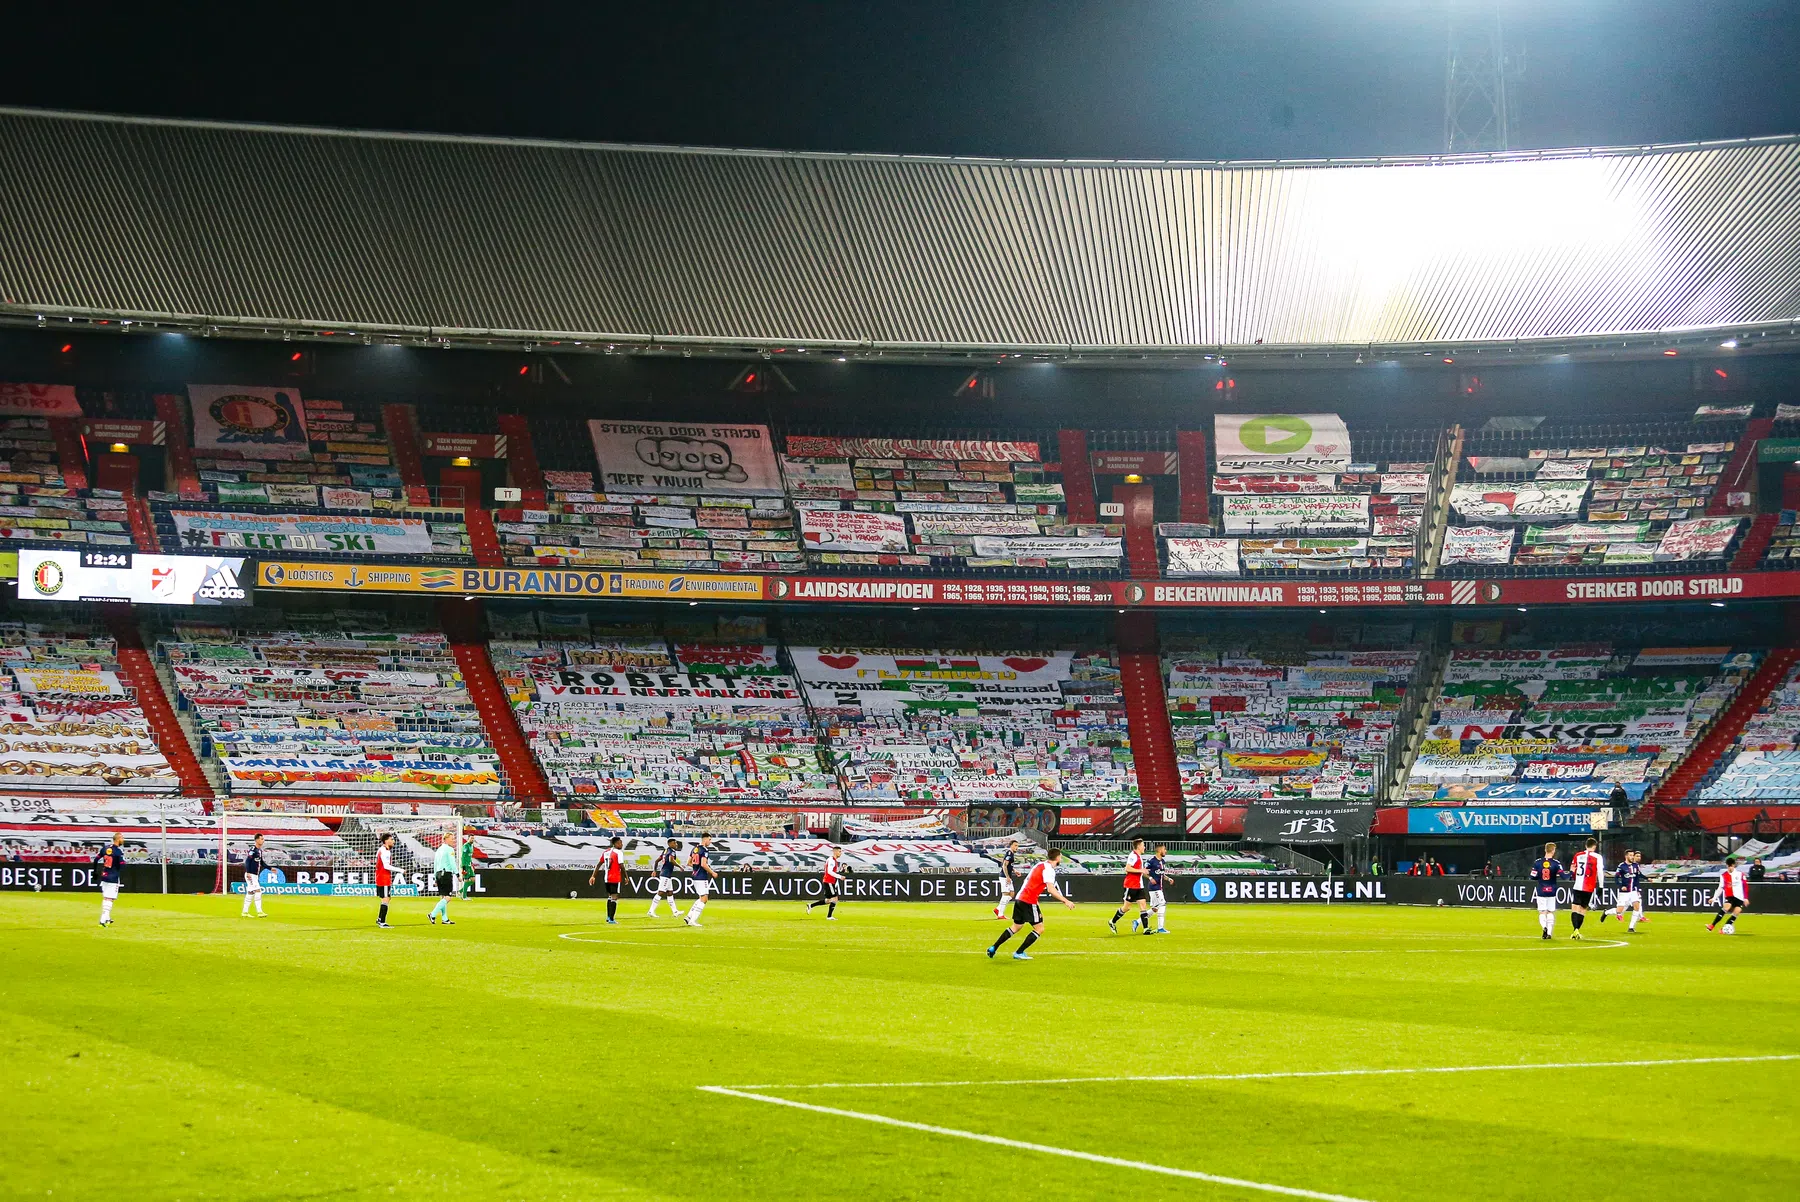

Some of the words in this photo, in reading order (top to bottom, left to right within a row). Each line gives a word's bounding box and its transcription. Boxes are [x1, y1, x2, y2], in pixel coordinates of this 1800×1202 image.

[647, 452, 723, 464] 1908
[504, 490, 512, 498] TT
[1106, 505, 1118, 513] UU
[85, 554, 127, 566] 12:24
[287, 571, 333, 581] LOGISTICS
[367, 572, 409, 583] SHIPPING
[460, 569, 602, 593] BURANDO
[621, 578, 660, 589] TRADING
[680, 580, 751, 592] ENVIRONMENTAL
[942, 584, 962, 594] 1924,
[964, 584, 984, 594] 1928,
[985, 584, 1006, 594] 1936,
[1007, 585, 1028, 594] 1938,
[1029, 585, 1049, 594] 1940,
[1051, 585, 1071, 594] 1961,
[1072, 585, 1090, 594] 1962
[1566, 580, 1637, 599] STERKER
[1642, 579, 1687, 597] DOOR
[1689, 577, 1743, 596] STRIJD
[198, 586, 245, 599] adidas
[794, 581, 934, 600] LANDSKAMPIOEN
[1154, 587, 1283, 603] BEKERWINNAAR
[1297, 586, 1318, 595] 1930,
[1319, 586, 1340, 595] 1935,
[1340, 586, 1361, 595] 1965,
[1362, 586, 1383, 595] 1969,
[1383, 585, 1404, 595] 1980,
[1405, 585, 1424, 594] 1984
[942, 592, 962, 602] 1965,
[964, 593, 984, 602] 1969,
[985, 593, 1006, 602] 1971,
[1007, 593, 1027, 602] 1974,
[1029, 593, 1049, 602] 1984,
[1051, 593, 1071, 602] 1993,
[1072, 593, 1093, 602] 1999,
[1094, 593, 1113, 602] 2017
[1297, 594, 1318, 604] 1991,
[1319, 594, 1340, 604] 1992,
[1340, 594, 1361, 604] 1994,
[1362, 594, 1383, 604] 1995,
[1383, 594, 1404, 604] 2008,
[1404, 593, 1425, 603] 2016,
[1426, 593, 1445, 602] 2018
[559, 671, 742, 688] ROBERT
[629, 687, 692, 698] NEVER
[693, 688, 744, 699] WALK
[743, 689, 799, 699] ALONE
[1460, 723, 1628, 740] NIKKO
[1166, 811, 1174, 820] U
[1305, 809, 1324, 817] gaan
[1324, 808, 1332, 816] je
[1333, 806, 1359, 814] missen
[1060, 817, 1092, 826] TRIBUNE
[1458, 811, 1592, 828] VRIENDENLOTER
[1541, 867, 1551, 881] 8
[1576, 861, 1594, 877] 33
[2, 867, 62, 886] BESTE
[707, 877, 752, 895] ALLE
[920, 879, 946, 896] DE
[1225, 881, 1386, 898] BREELEASE.NL
[1457, 884, 1494, 902] VOOR
[1498, 885, 1526, 903] ALLE
[1647, 888, 1687, 906] BESTE
